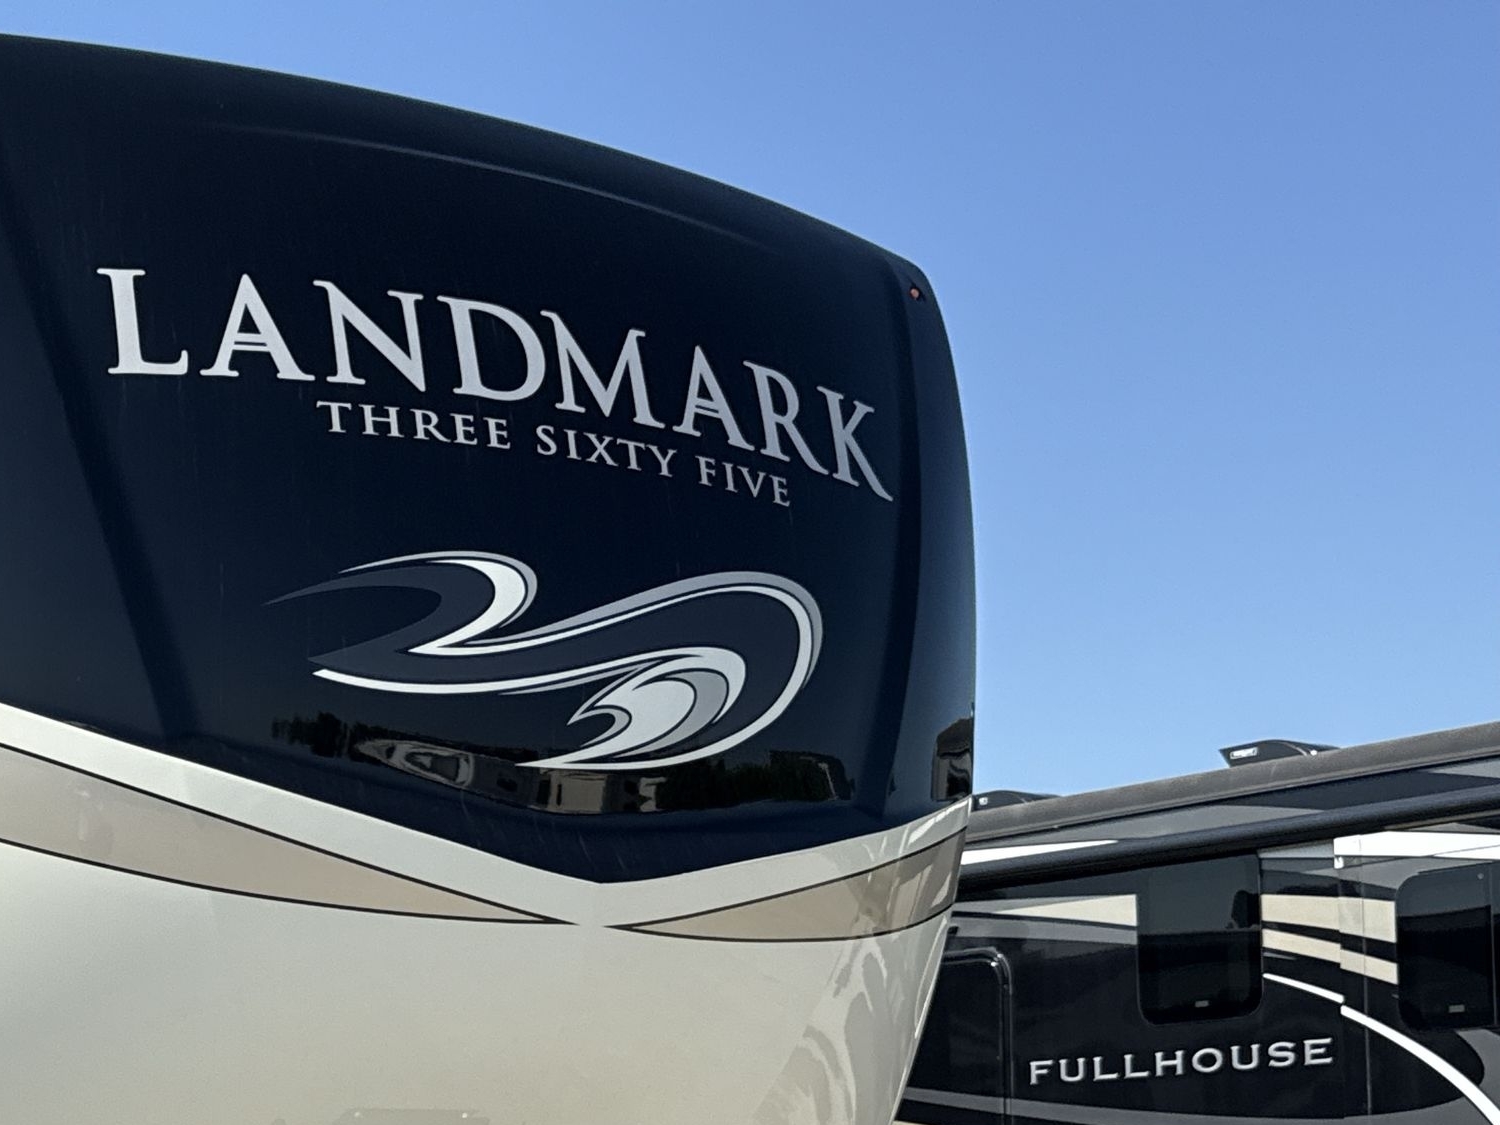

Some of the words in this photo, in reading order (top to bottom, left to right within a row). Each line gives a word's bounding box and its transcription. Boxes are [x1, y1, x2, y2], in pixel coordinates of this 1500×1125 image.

[96, 267, 894, 503] LANDMARK
[316, 400, 511, 450] THREE
[536, 425, 677, 478] SIXTY
[695, 455, 791, 508] FIVE
[1029, 1037, 1333, 1085] FULLHOUSE
